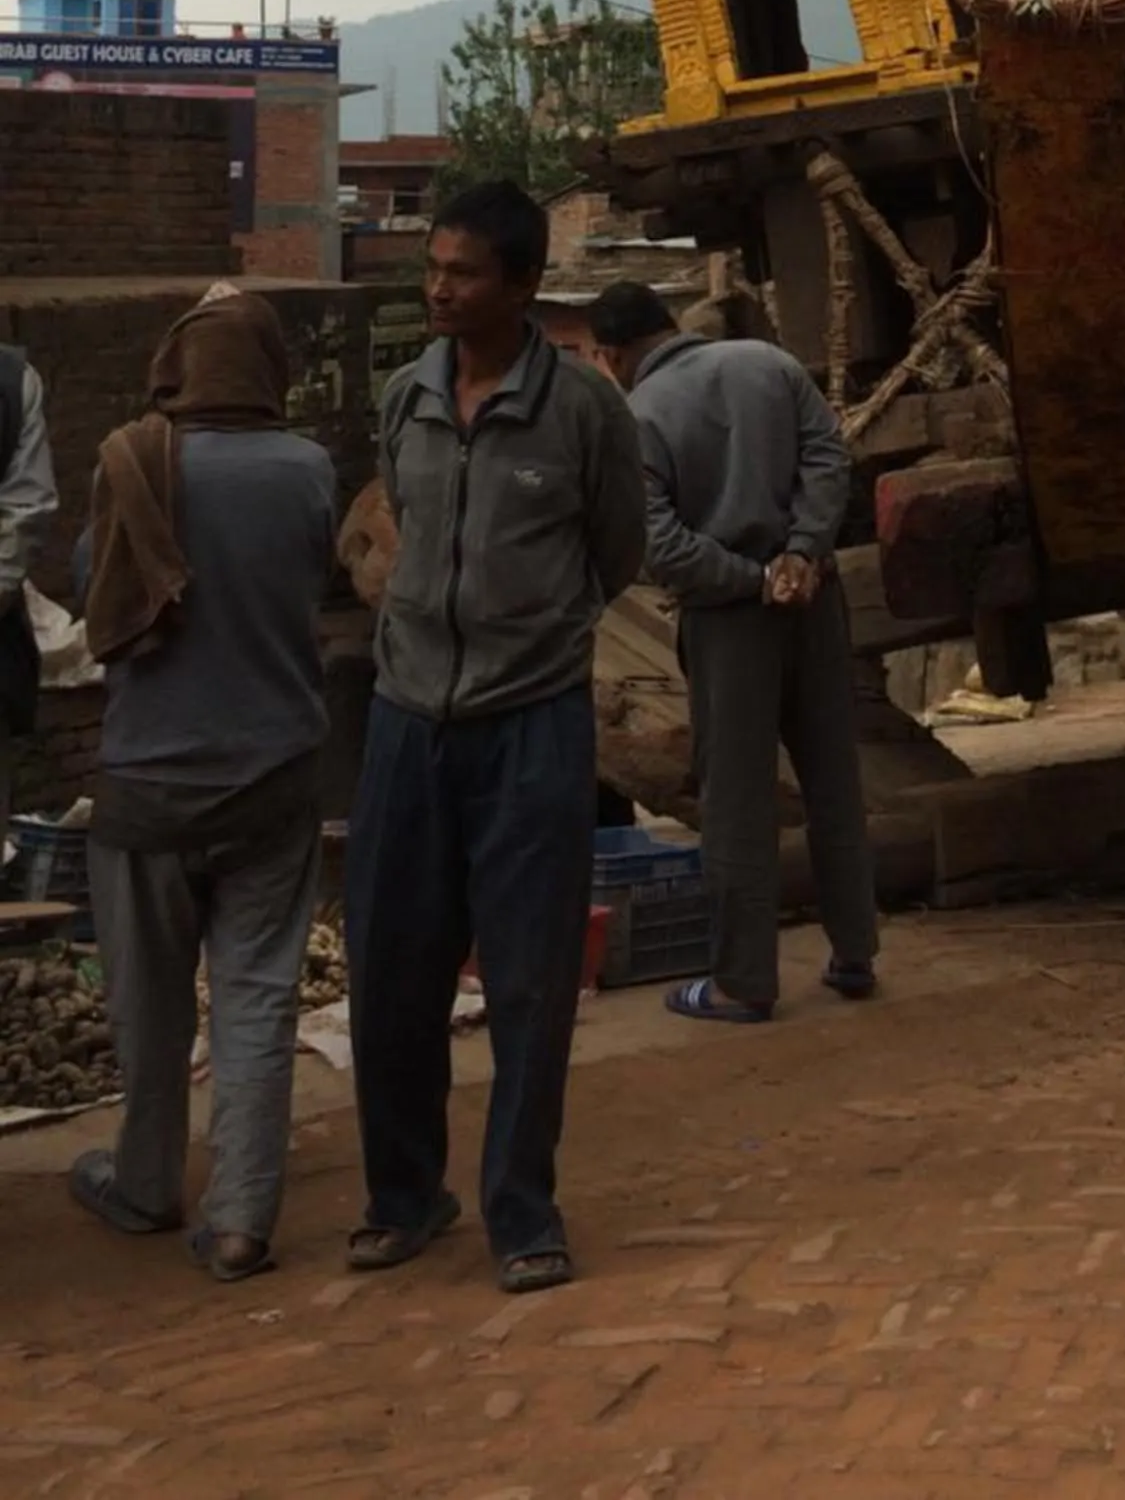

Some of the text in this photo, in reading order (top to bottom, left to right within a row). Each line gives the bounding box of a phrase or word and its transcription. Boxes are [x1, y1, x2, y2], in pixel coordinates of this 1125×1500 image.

[41, 43, 90, 61] GUEST
[93, 44, 145, 62] HOUSE
[148, 46, 159, 63] &
[162, 45, 212, 64] CYBER
[214, 46, 254, 65] CAFE
